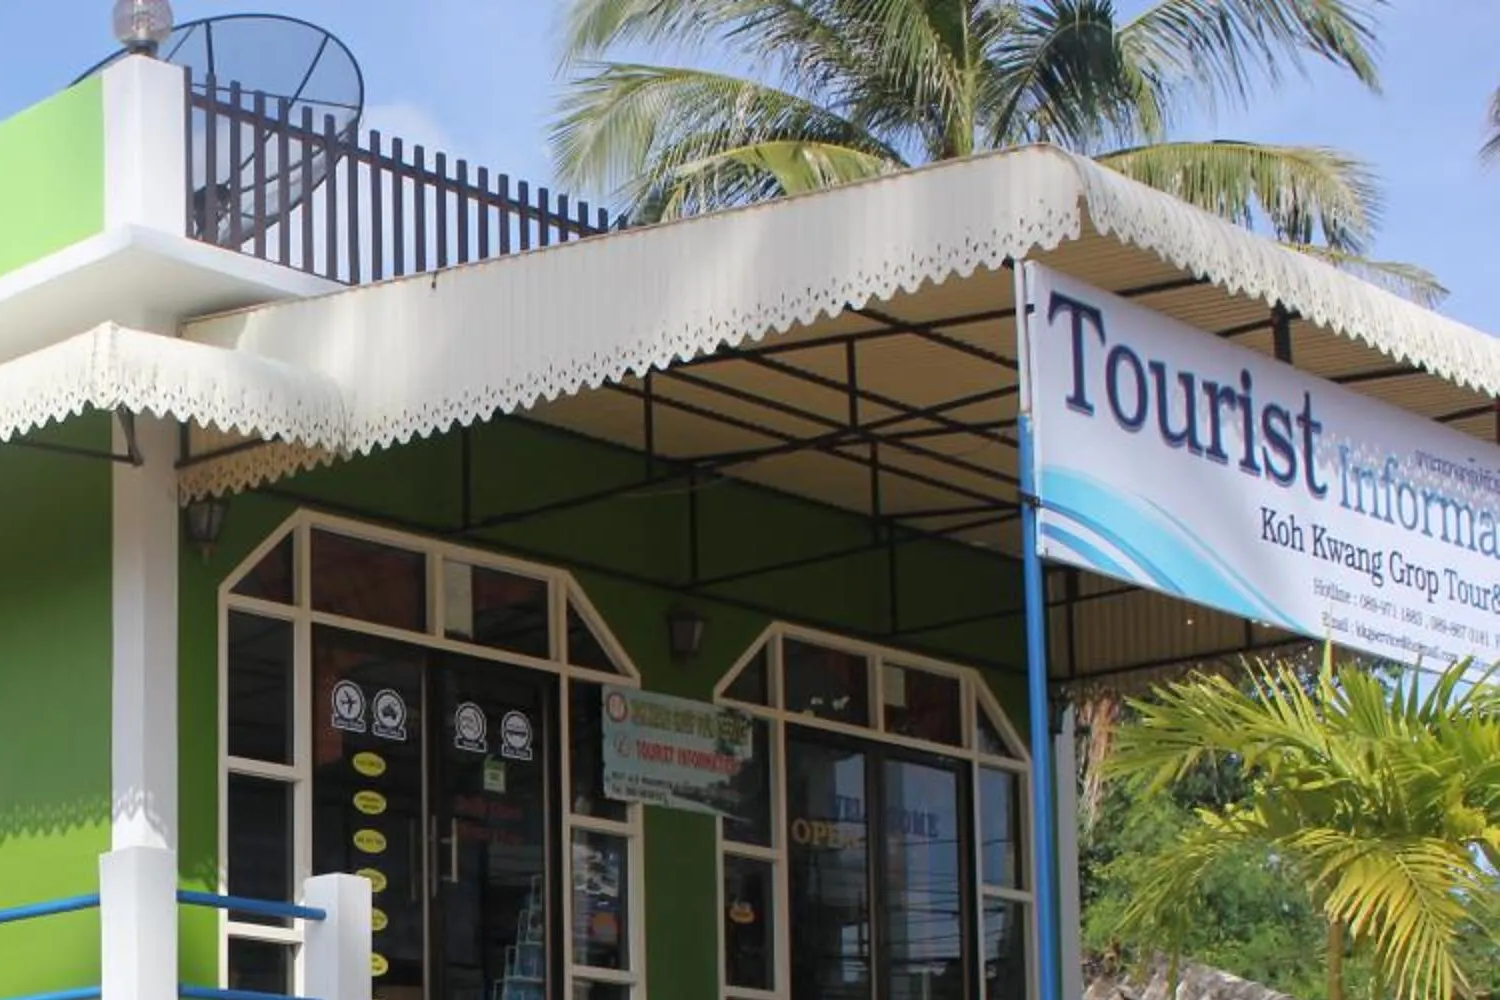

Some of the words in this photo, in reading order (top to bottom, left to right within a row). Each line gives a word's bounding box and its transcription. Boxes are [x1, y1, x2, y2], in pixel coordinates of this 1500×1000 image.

[1047, 291, 1329, 499] Tourist
[1260, 506, 1305, 554] Koh
[1311, 524, 1384, 588] Kwang
[1388, 549, 1440, 604] Grop
